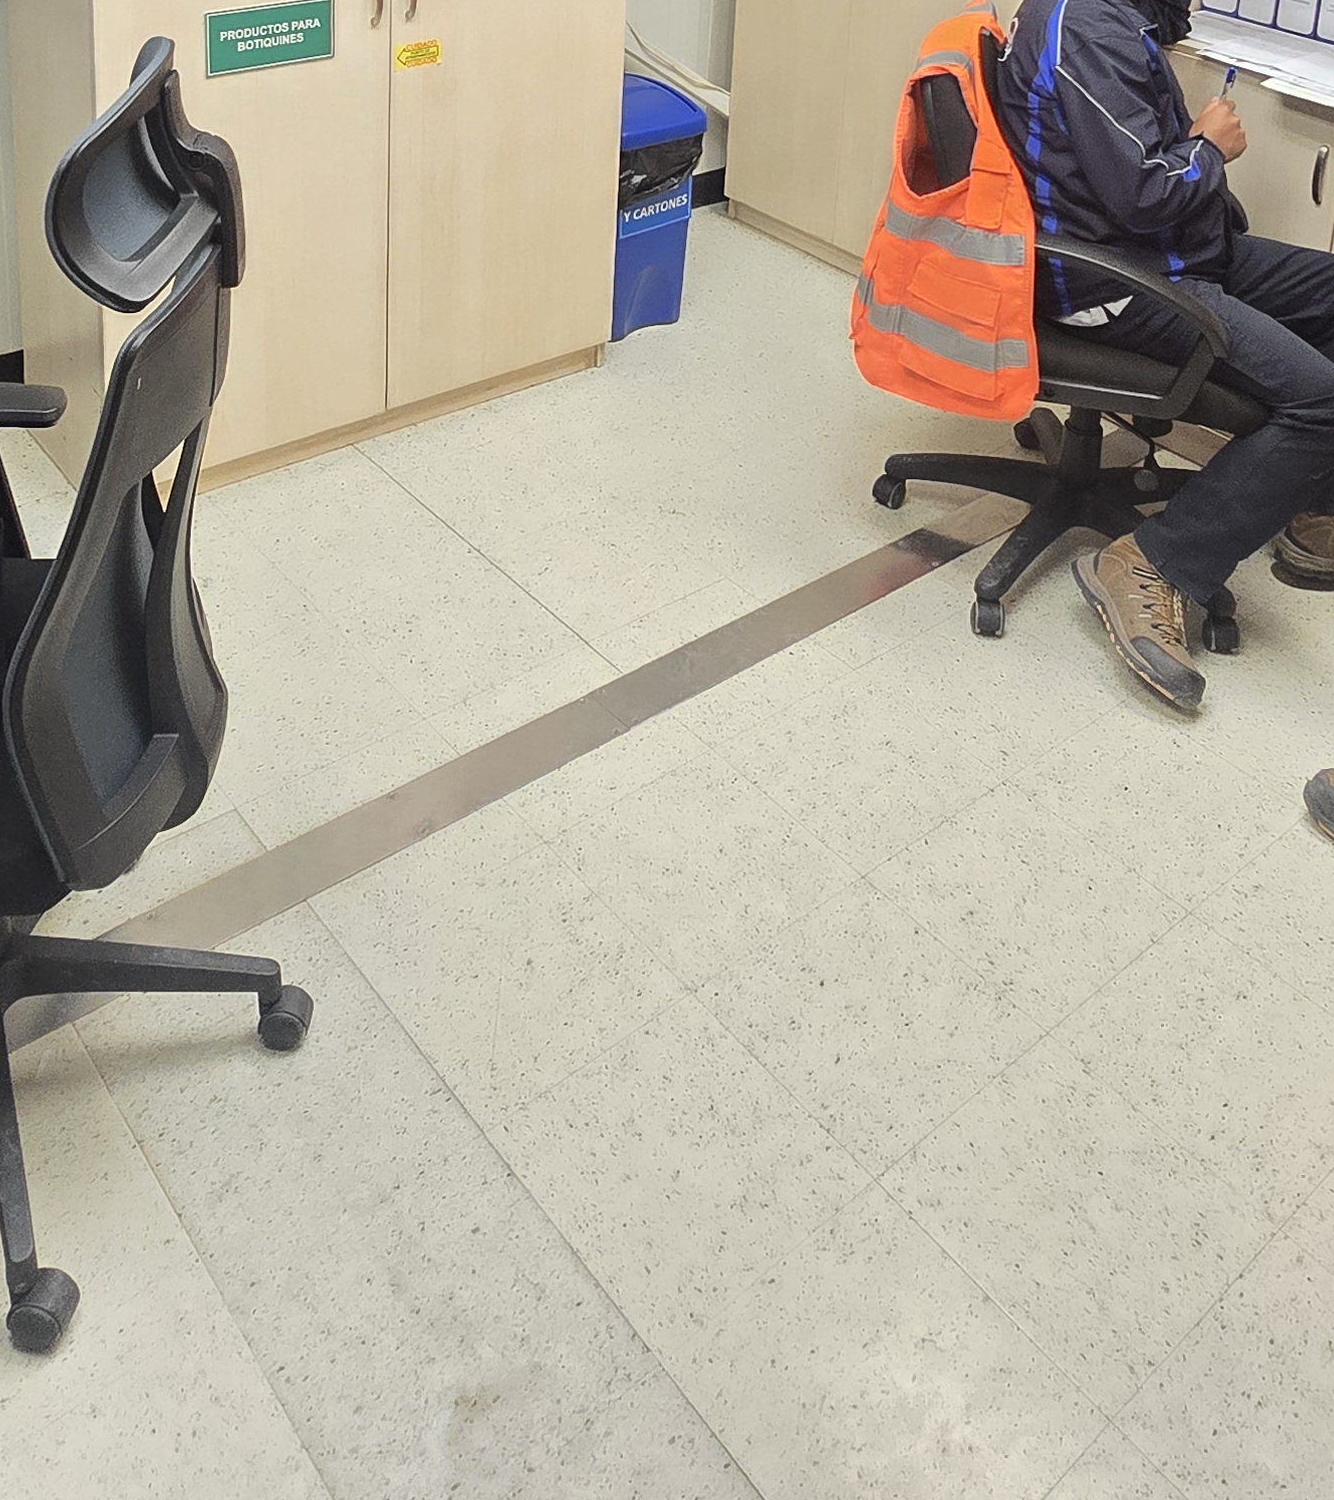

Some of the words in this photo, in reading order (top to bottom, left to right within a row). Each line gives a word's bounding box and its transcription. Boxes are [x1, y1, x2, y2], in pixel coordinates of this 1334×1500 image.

[219, 22, 289, 42] PRODUCTOS
[291, 18, 321, 31] PARA
[237, 32, 304, 52] BOTIQUINES
[406, 40, 437, 51] CUIDADO
[623, 212, 632, 223] Y
[633, 194, 688, 220] CARTONES
